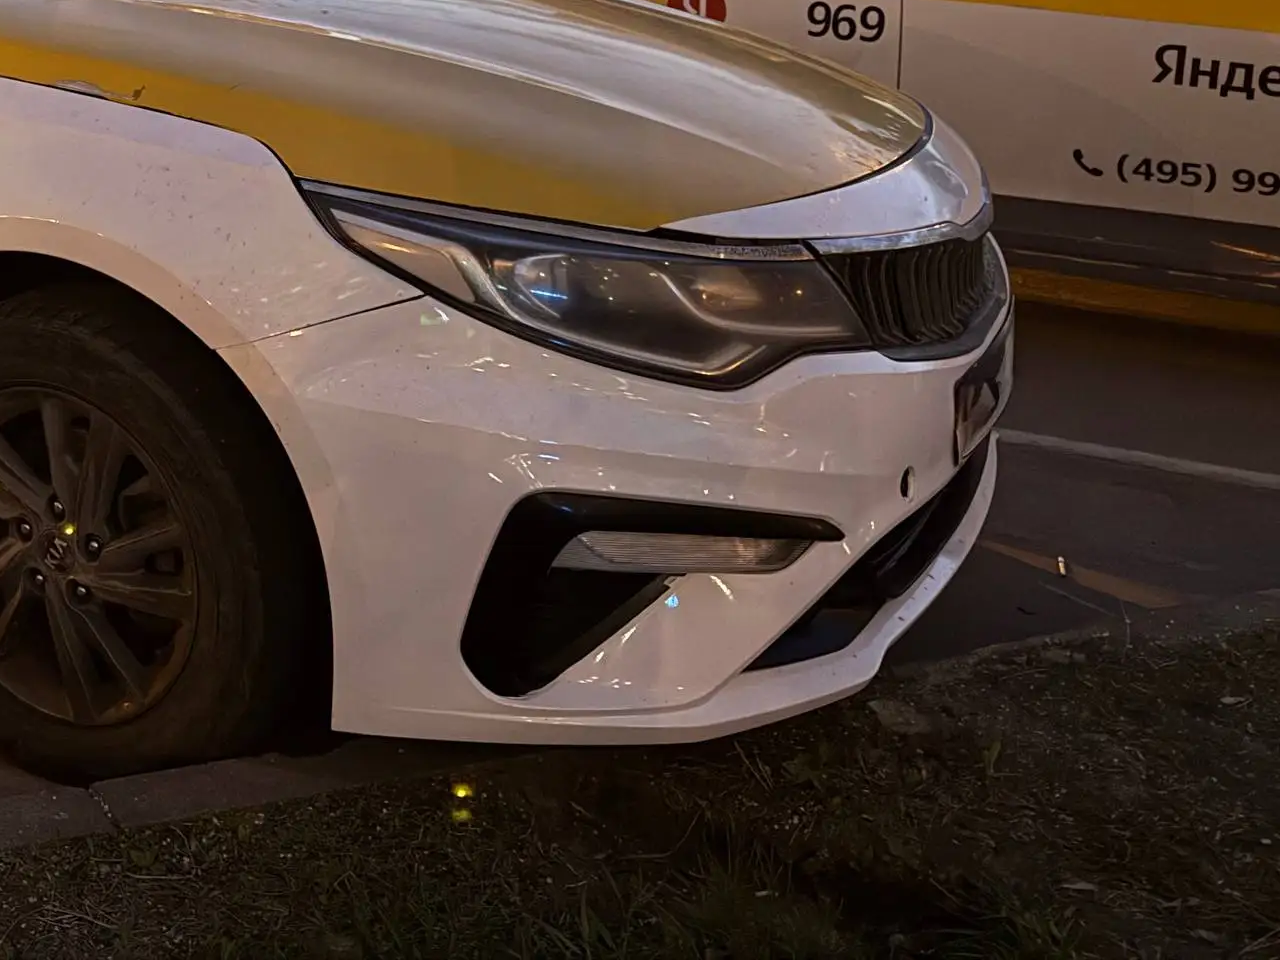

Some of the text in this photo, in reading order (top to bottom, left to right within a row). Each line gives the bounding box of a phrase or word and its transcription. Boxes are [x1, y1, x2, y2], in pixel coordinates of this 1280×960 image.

[806, 1, 886, 43] 969
[1152, 44, 1280, 100] Янде
[1116, 154, 1280, 196] (495) 99
